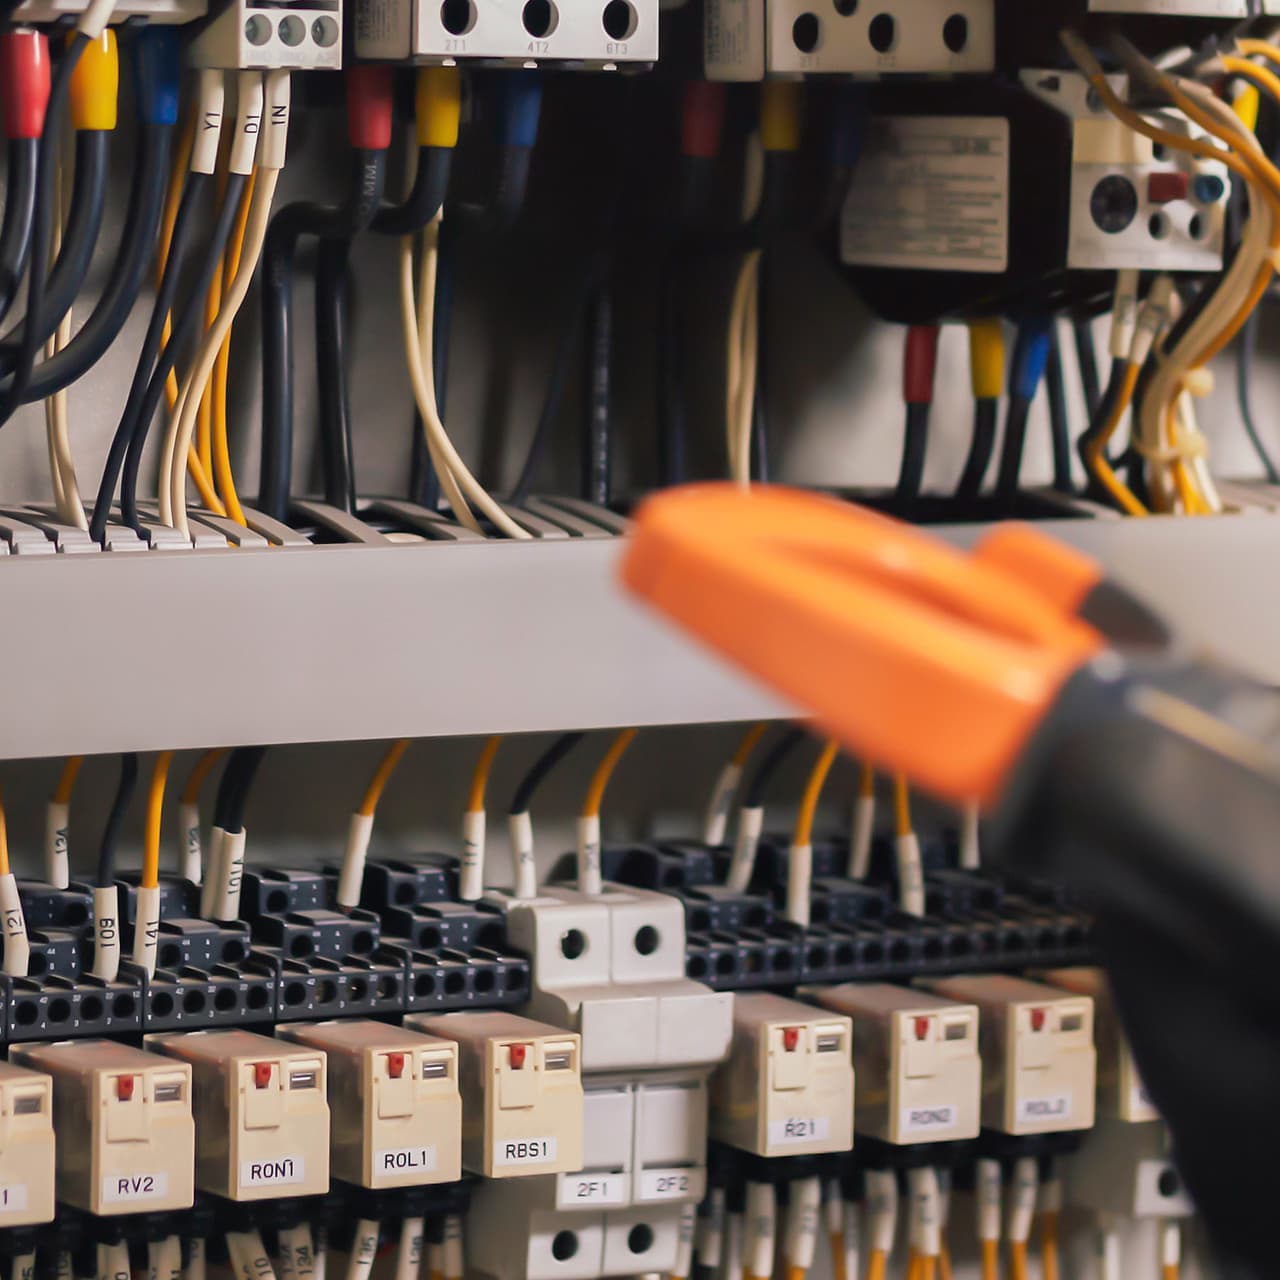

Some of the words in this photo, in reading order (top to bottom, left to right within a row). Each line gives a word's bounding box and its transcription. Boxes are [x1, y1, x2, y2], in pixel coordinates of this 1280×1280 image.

[443, 38, 468, 53] 2T1
[527, 41, 551, 56] 4T2
[203, 111, 221, 131] Y1
[243, 114, 261, 134] D1
[6, 908, 24, 938] 121
[99, 917, 116, 950] 109
[144, 920, 159, 949] 141
[910, 1108, 951, 1126] RON2
[783, 1120, 815, 1138] R21
[505, 1141, 548, 1159] RBS1
[384, 1150, 427, 1169] ROL1
[251, 1161, 294, 1180] RON1
[118, 1176, 155, 1194] RV2
[576, 1181, 608, 1198] 2F1
[655, 1175, 690, 1193] 2F2
